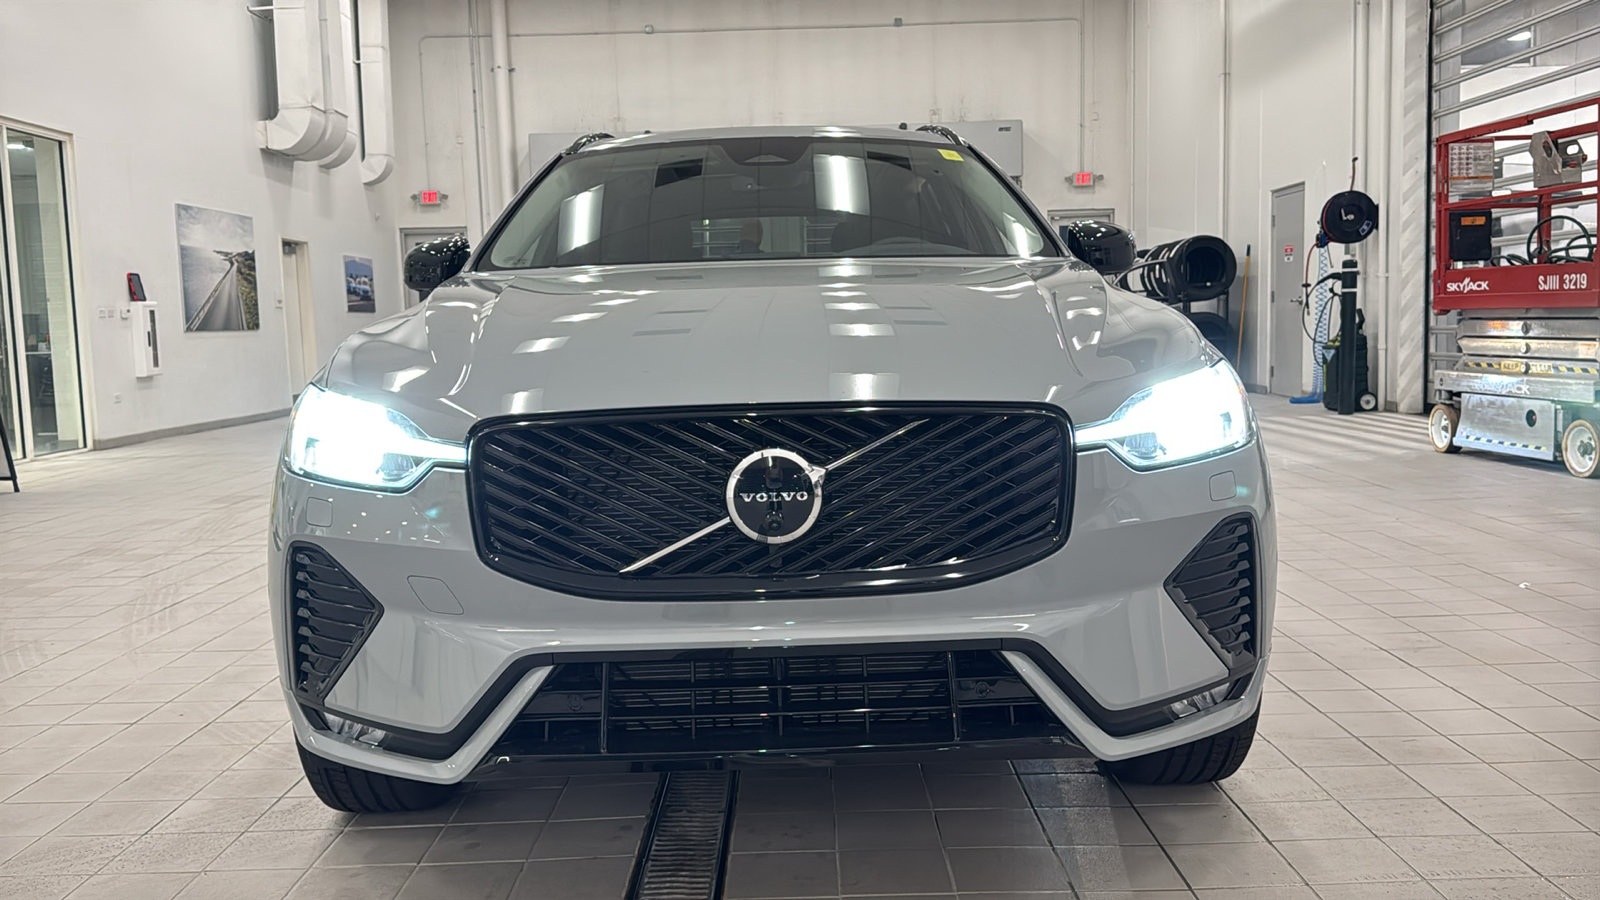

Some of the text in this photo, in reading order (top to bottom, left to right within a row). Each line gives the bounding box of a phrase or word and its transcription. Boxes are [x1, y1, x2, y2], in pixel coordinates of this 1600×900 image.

[1446, 277, 1489, 293] SKYJACK
[1538, 273, 1587, 290] SJIII 3219
[740, 491, 808, 502] VOLVO
